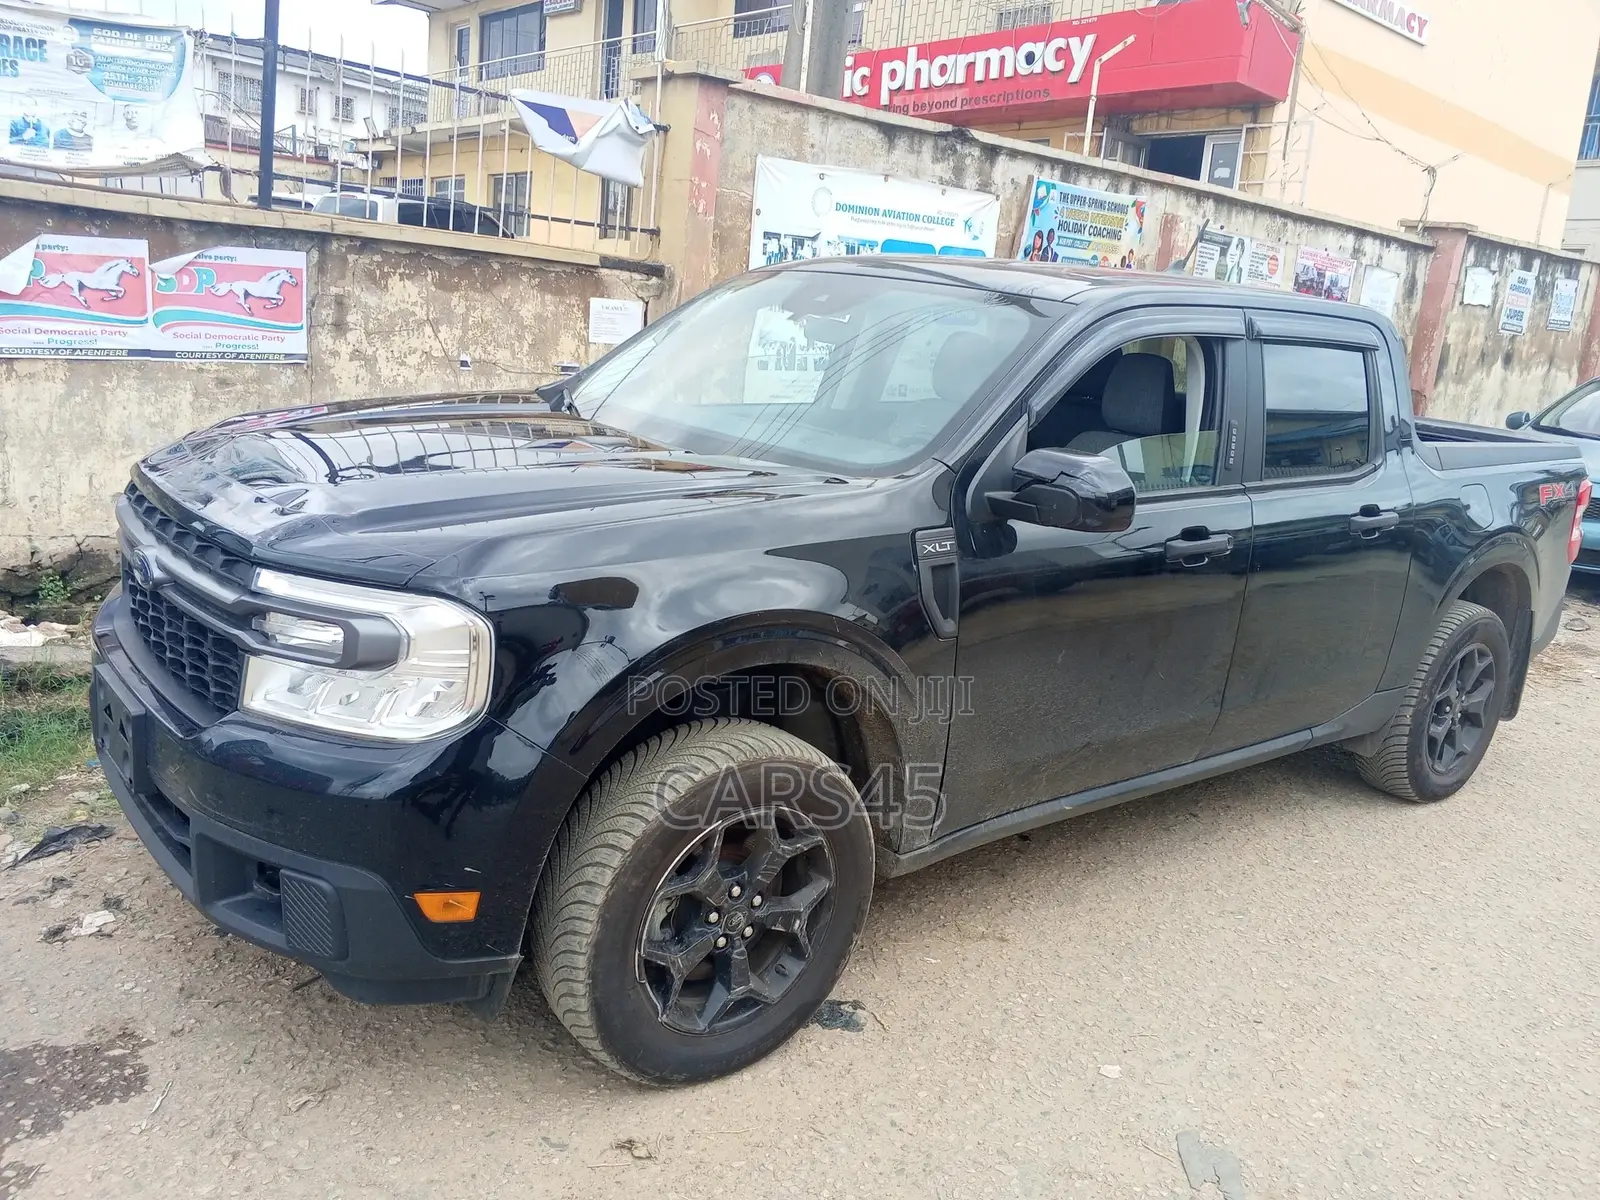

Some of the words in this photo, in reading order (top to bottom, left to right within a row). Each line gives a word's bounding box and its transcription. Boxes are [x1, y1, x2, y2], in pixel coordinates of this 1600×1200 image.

[92, 28, 120, 38] GOD
[124, 32, 141, 40] OF
[145, 34, 172, 44] OUR
[104, 72, 128, 80] 25TH
[880, 34, 1098, 105] pharmacy
[912, 96, 958, 113] beyond
[960, 86, 1050, 108] prescriptions
[1060, 192, 1069, 202] THE
[1070, 194, 1106, 211] UPPER-SPRING
[1107, 201, 1130, 214] SCHOOLS
[835, 202, 880, 216] DOMINION
[882, 208, 920, 224] AVIATION
[922, 215, 956, 227] COLLEGE
[1058, 220, 1088, 236] HOLIDAY
[1088, 225, 1122, 240] COACHING
[42, 244, 68, 252] party:
[34, 328, 98, 336] Democratic
[100, 329, 128, 338] Party
[172, 332, 202, 340] Social
[204, 332, 260, 341] Democratic
[262, 334, 286, 343] Party
[48, 338, 98, 346] Progress!
[216, 342, 258, 350] Progress!
[1539, 480, 1576, 507] FX4
[922, 541, 955, 554] XLT
